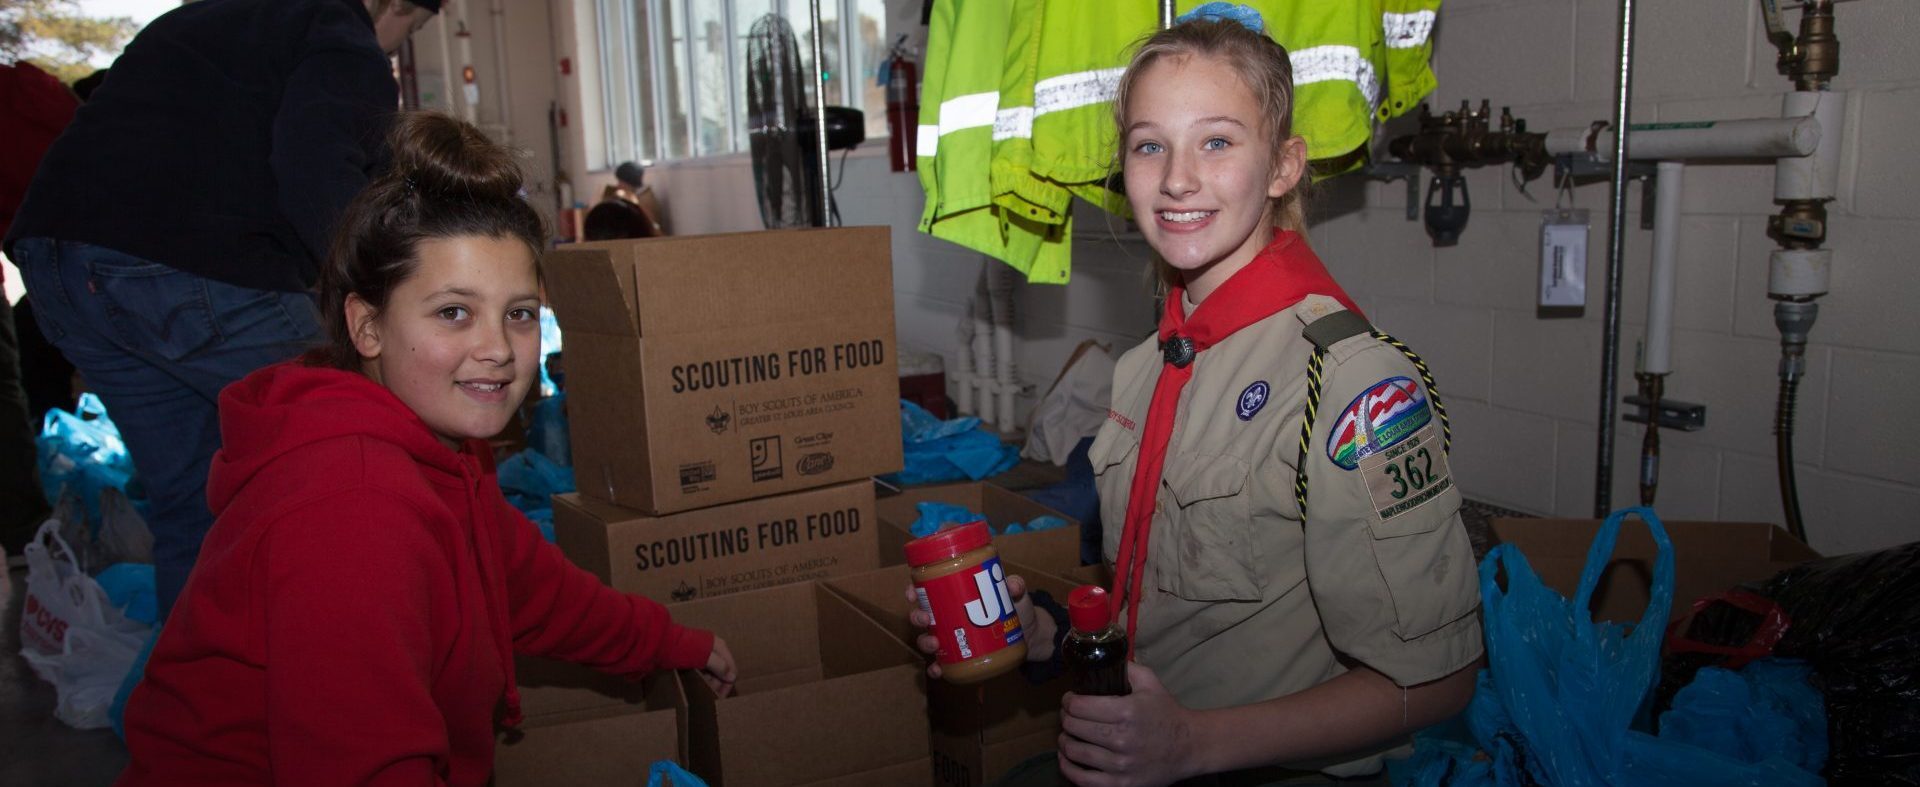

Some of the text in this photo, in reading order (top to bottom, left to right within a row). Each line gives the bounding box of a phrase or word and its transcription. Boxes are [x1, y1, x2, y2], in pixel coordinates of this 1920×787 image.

[671, 339, 884, 394] SCOUTING FOR FOOD
[739, 387, 863, 415] BOY SCOUTS OF AMERICA
[1385, 440, 1407, 460] SINCE
[1384, 447, 1438, 499] 362
[635, 508, 860, 571] SCOUTING FOR FOOD
[706, 556, 840, 589] BOY SCOUTS OF AMERICA
[37, 606, 69, 642] CVS
